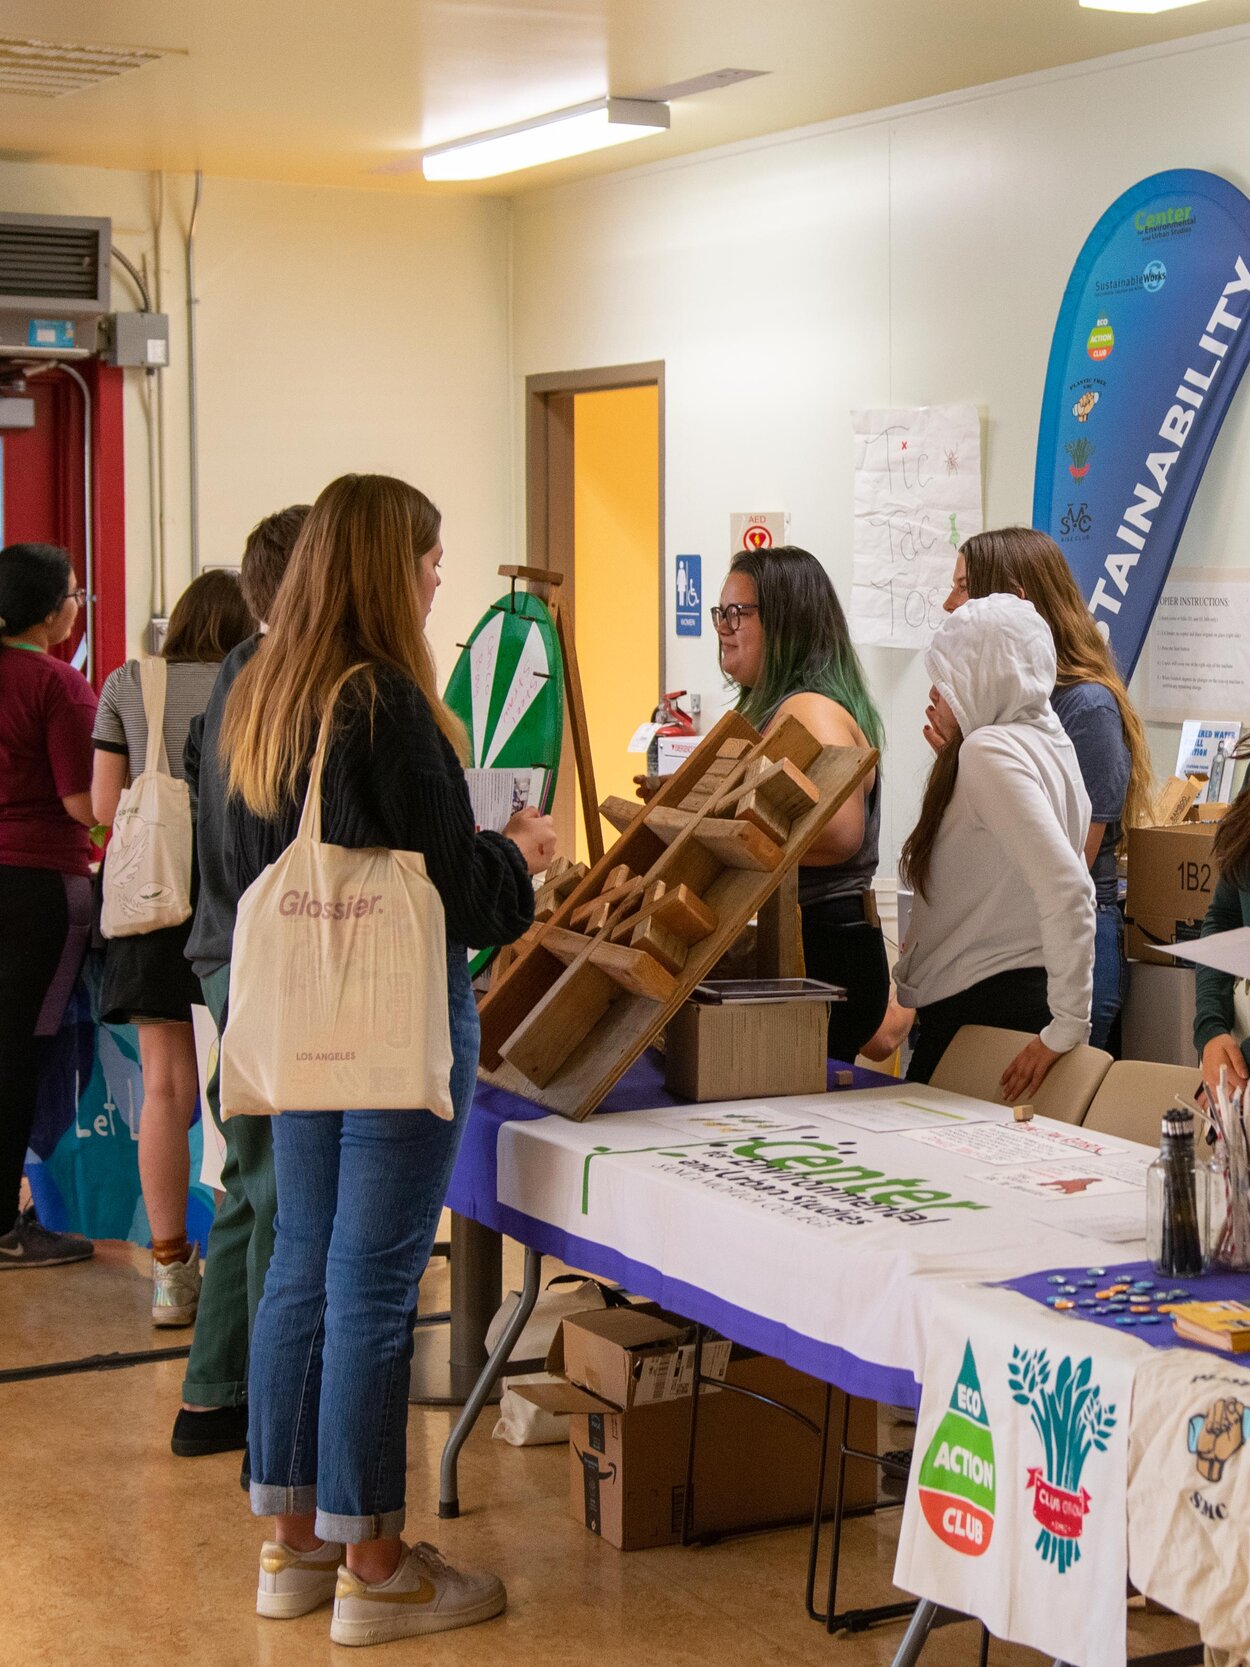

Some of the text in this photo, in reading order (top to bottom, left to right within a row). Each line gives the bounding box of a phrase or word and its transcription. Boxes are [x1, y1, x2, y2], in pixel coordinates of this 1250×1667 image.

[1134, 205, 1192, 232] Center
[1144, 216, 1197, 234] Environmental
[1151, 230, 1170, 240] Urban
[1095, 270, 1167, 292] SustainableWorks
[1096, 318, 1109, 326] ECO
[1090, 333, 1112, 343] ACTION
[1092, 349, 1107, 358] CLUB
[749, 515, 767, 524] AED
[1159, 596, 1179, 607] OPIER
[1177, 861, 1212, 893] 1B2
[278, 889, 384, 921] Glossier.
[296, 1050, 356, 1062] LOS ANGELES
[733, 1138, 991, 1212] Center
[678, 1159, 873, 1226] and Urban Studies
[727, 1157, 952, 1226] Environmental
[957, 1383, 981, 1420] ECO
[933, 1441, 994, 1491] ACTION
[1039, 1488, 1060, 1513] CLUB
[1190, 1490, 1229, 1520] SMC
[942, 1507, 985, 1546] CLUB
